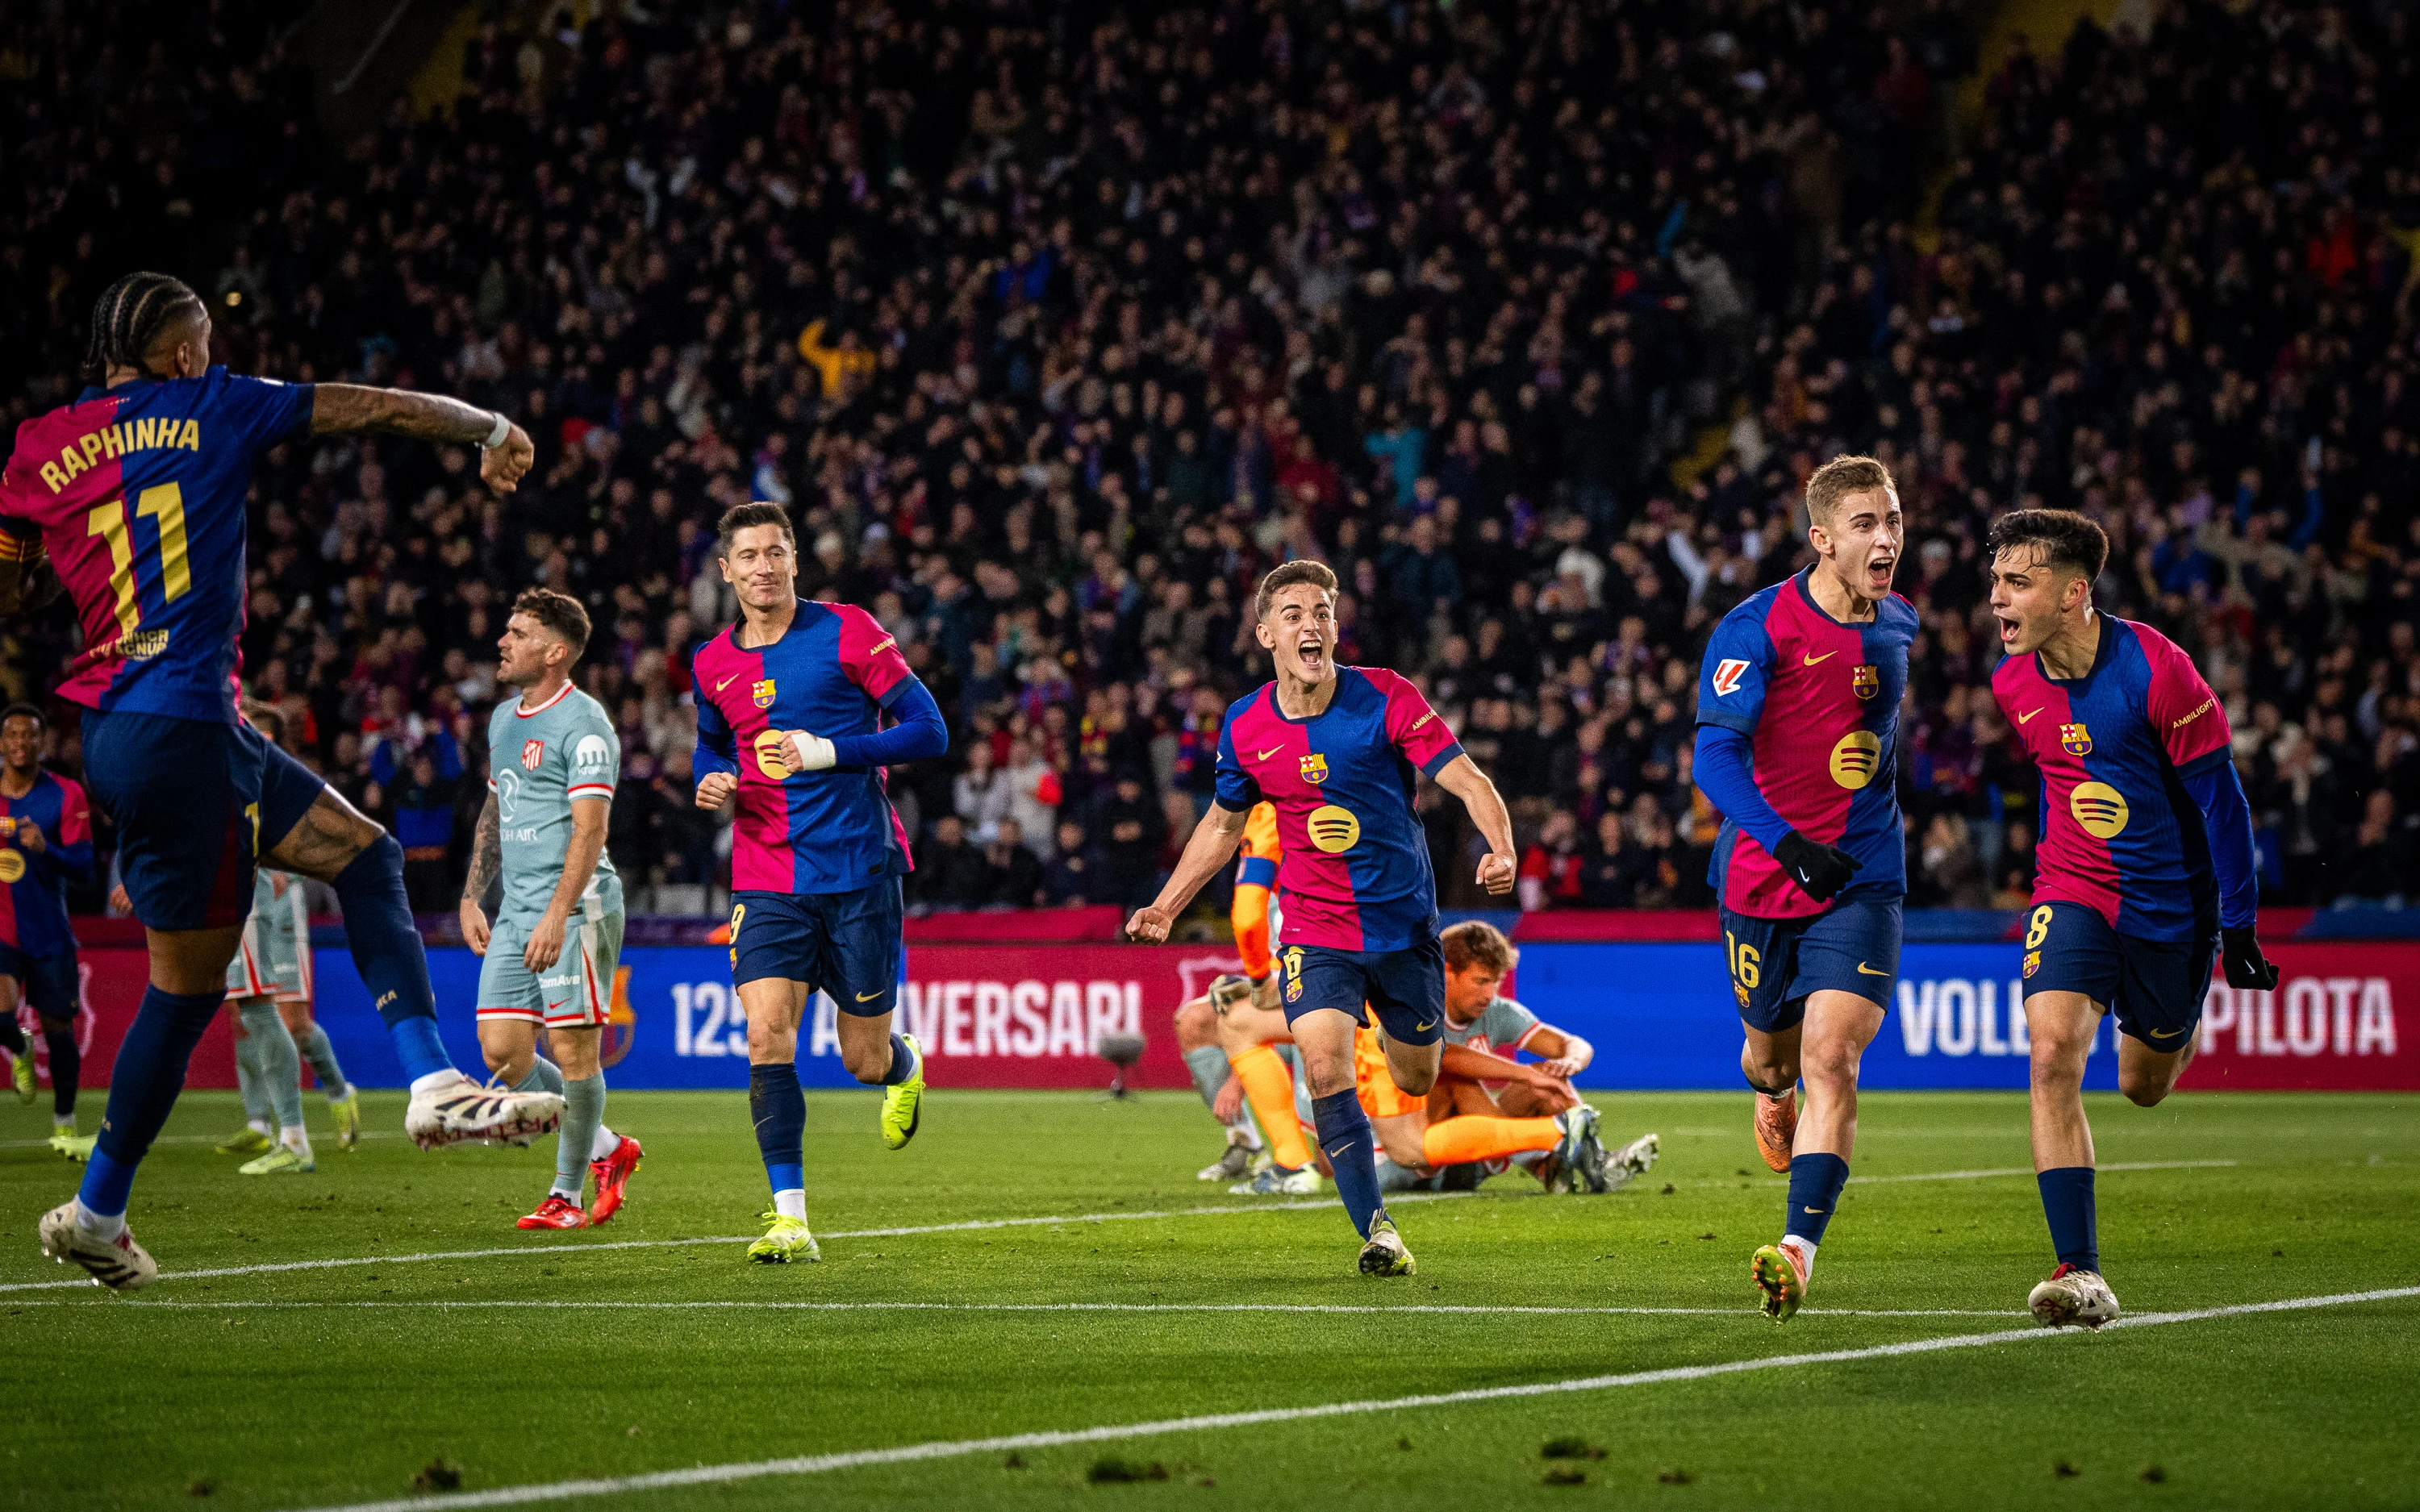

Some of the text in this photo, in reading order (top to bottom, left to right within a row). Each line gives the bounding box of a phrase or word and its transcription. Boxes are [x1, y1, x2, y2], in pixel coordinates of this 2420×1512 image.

[40, 417, 199, 494] RAPHINHA
[87, 481, 191, 635] 11
[2173, 698, 2213, 729] AMBILIGHT
[516, 828, 540, 842] AIR
[729, 903, 745, 944] 9
[2026, 905, 2053, 950] 8
[1283, 946, 1305, 981] 6
[1726, 930, 1760, 989] 16
[2199, 976, 2398, 1057] PILOTA
